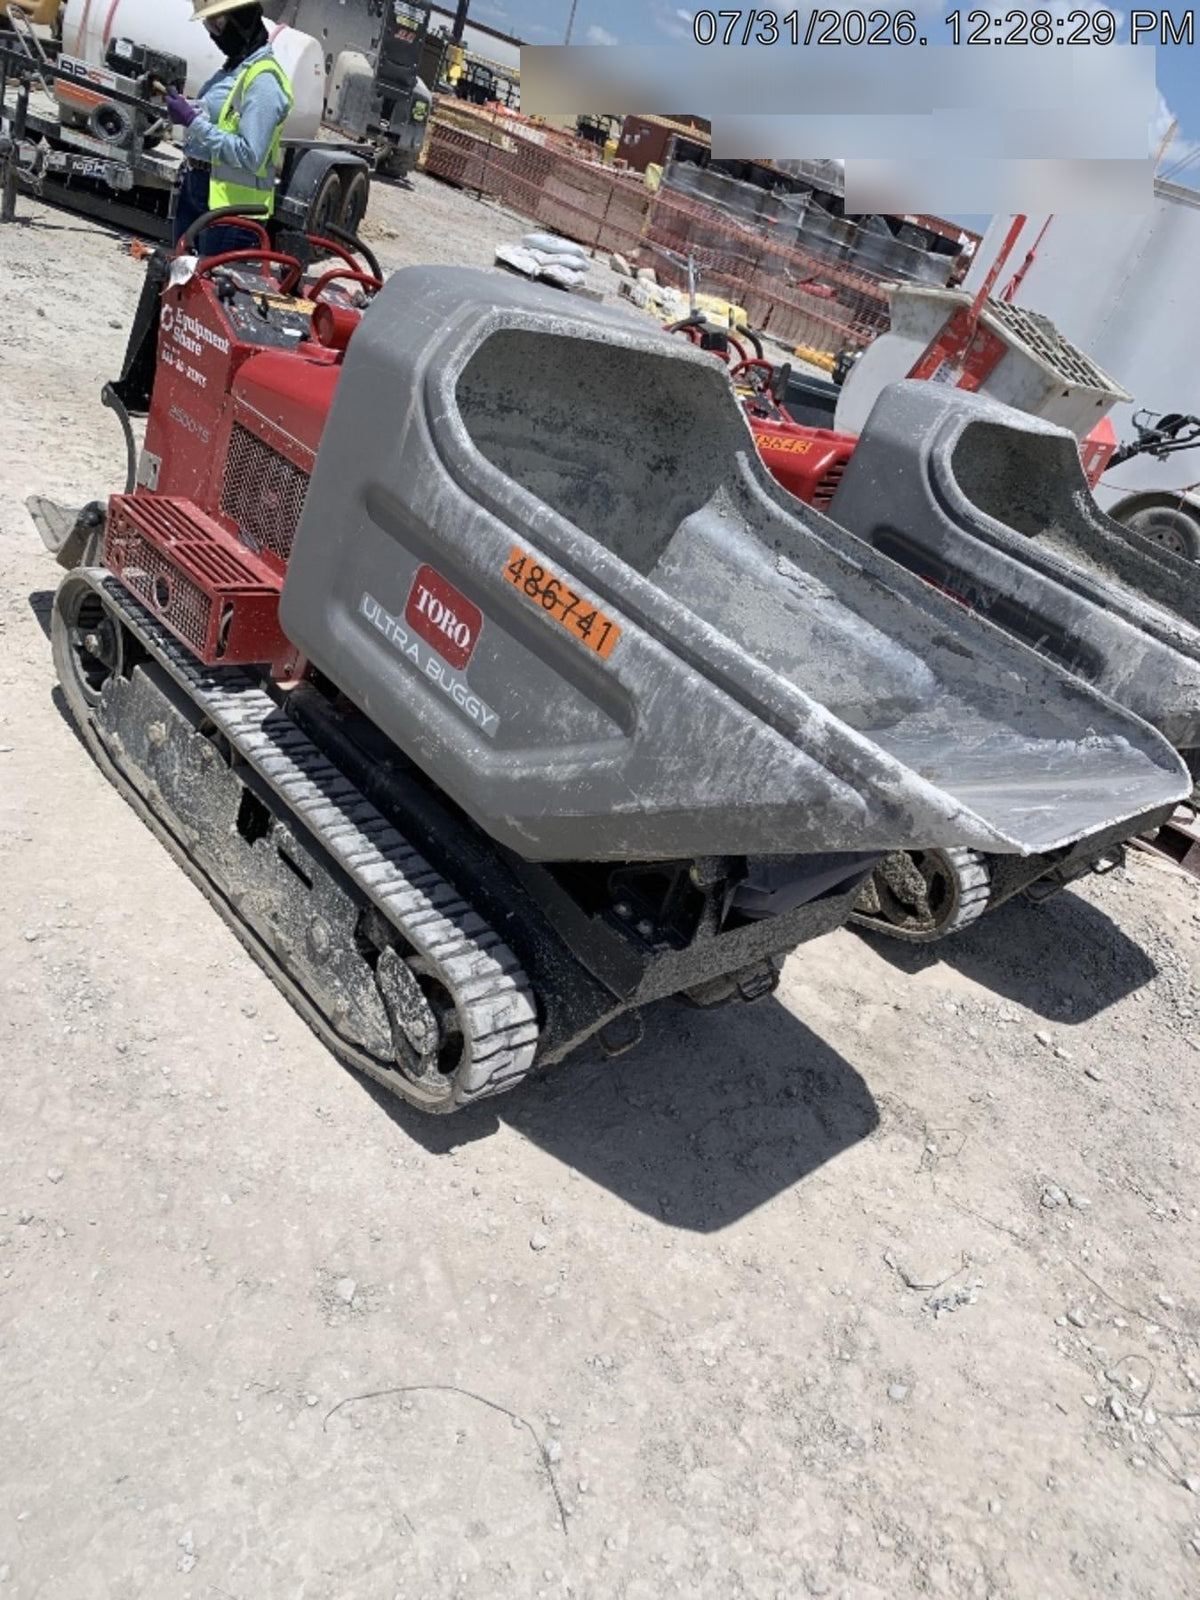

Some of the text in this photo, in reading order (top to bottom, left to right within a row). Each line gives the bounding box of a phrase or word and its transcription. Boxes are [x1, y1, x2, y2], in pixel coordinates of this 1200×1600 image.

[172, 327, 203, 355] Share
[175, 307, 230, 354] Equipment
[414, 585, 471, 649] TORO
[508, 557, 612, 651] 486741
[363, 597, 494, 726] ULTRA BUGGY
